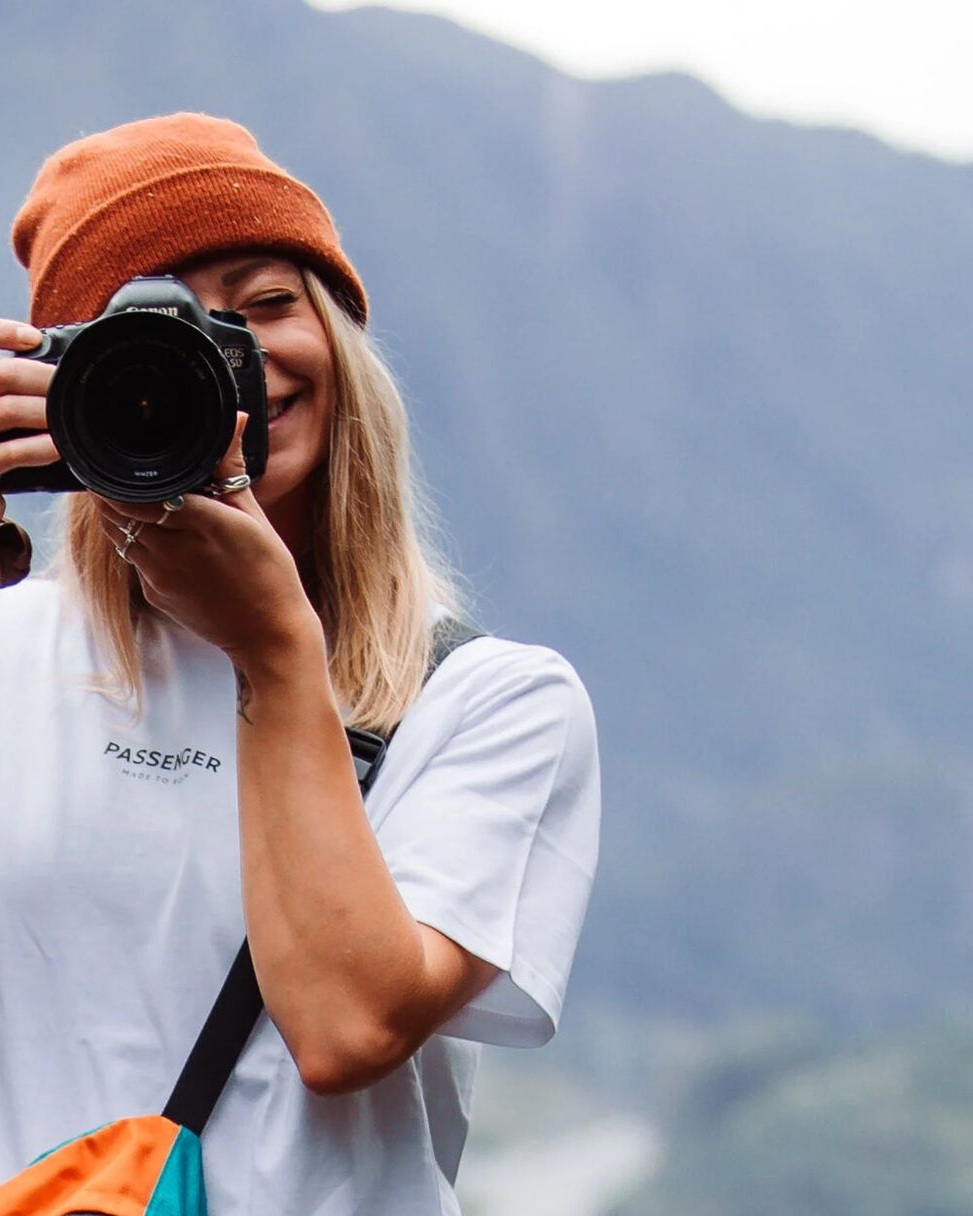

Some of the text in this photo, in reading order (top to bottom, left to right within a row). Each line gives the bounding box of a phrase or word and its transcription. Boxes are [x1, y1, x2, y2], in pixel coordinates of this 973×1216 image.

[224, 348, 245, 358] EOS
[229, 358, 243, 368] 5D
[104, 741, 221, 773] PASSENGER
[122, 769, 150, 781] MADE
[156, 775, 169, 784] TO
